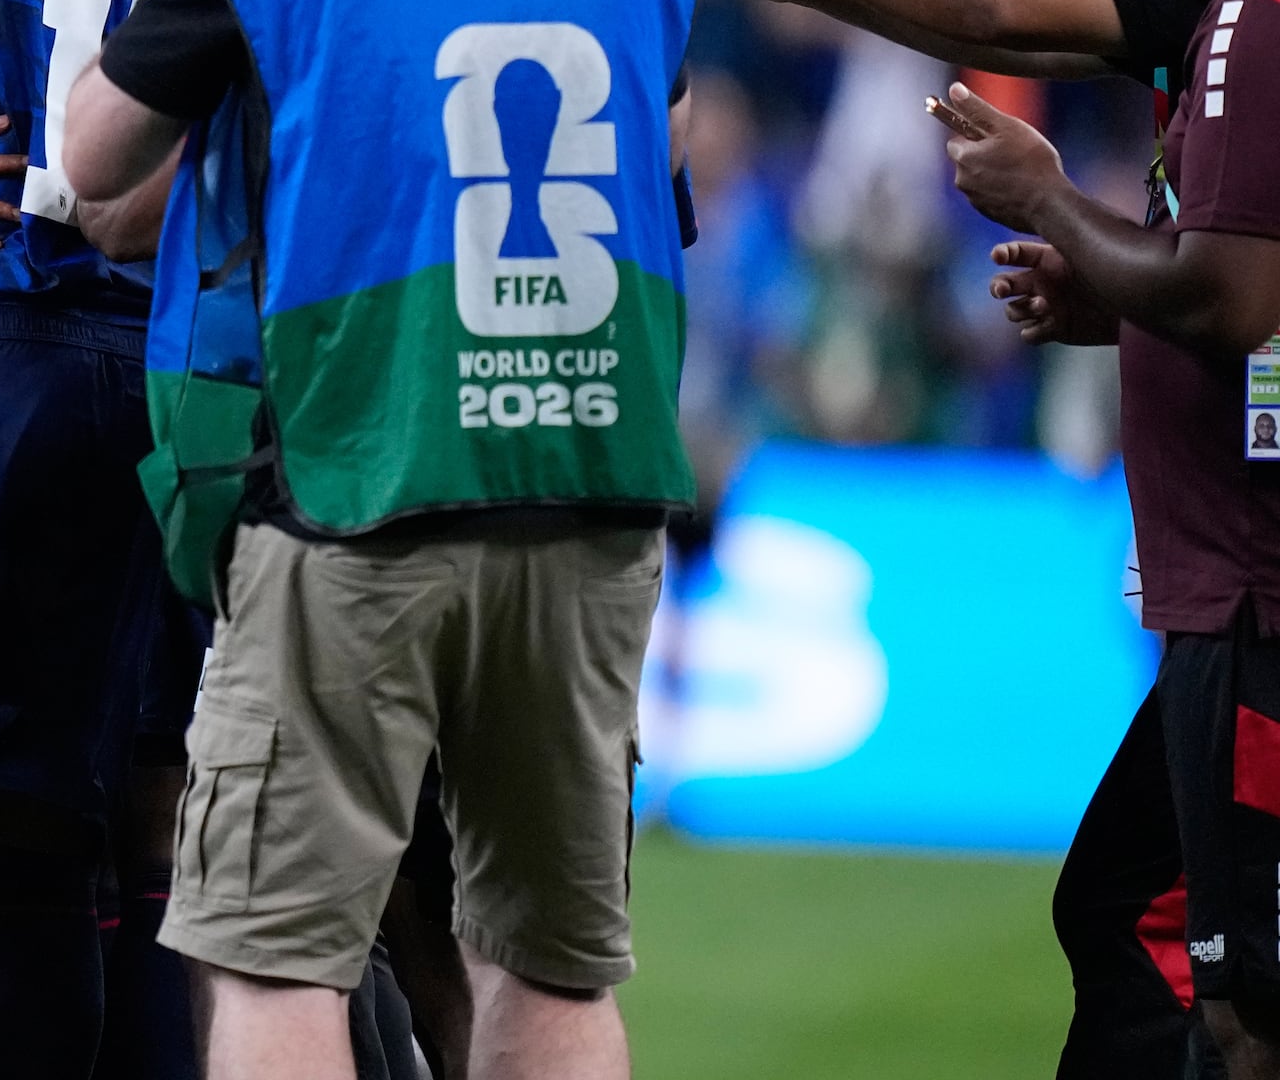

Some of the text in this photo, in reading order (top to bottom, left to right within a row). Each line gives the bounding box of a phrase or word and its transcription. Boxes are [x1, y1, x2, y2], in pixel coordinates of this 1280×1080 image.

[494, 275, 568, 307] FIFA
[457, 347, 620, 379] WORLD CUP
[458, 380, 620, 429] 2026
